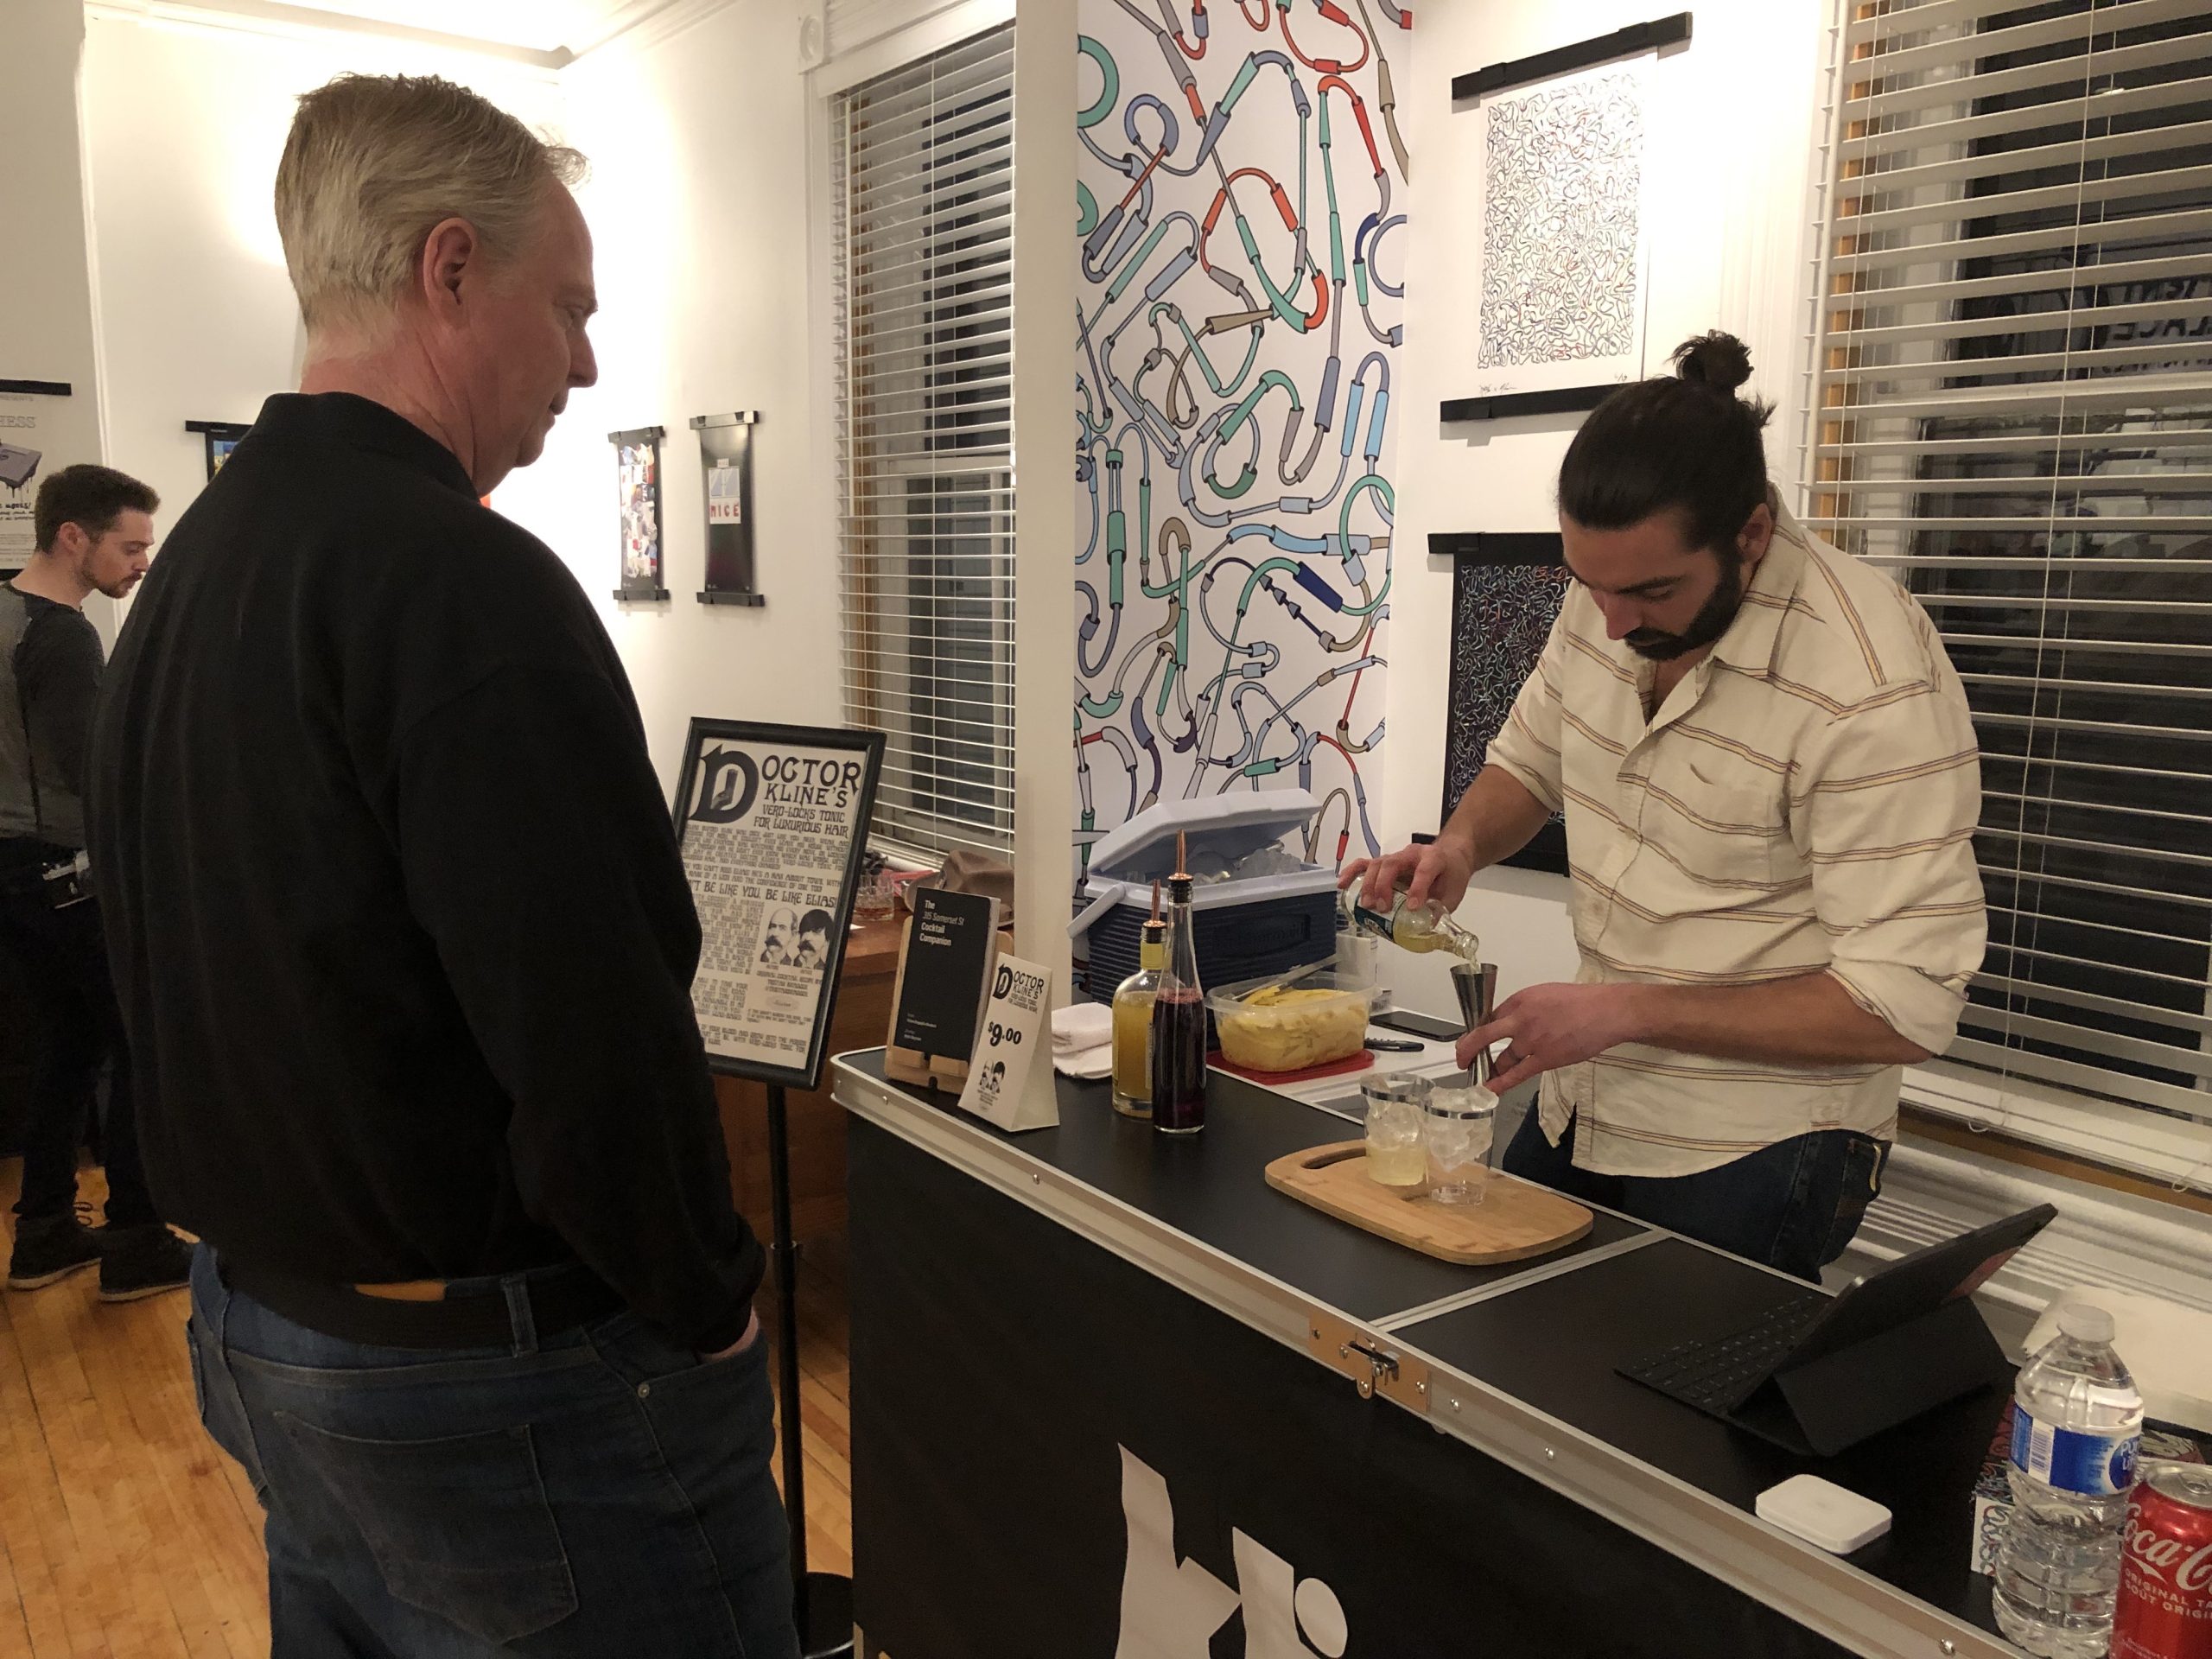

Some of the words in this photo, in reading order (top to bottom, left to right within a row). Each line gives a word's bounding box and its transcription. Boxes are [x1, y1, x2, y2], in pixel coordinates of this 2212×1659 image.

[688, 744, 861, 823] DOCTOR
[765, 783, 849, 808] KLINE'S
[753, 817, 770, 830] FOR
[773, 819, 822, 834] LUXURIOUS
[826, 824, 849, 838] HAIR
[820, 810, 845, 823] TONIC
[704, 881, 715, 893] BE
[719, 883, 738, 896] LIKE
[766, 888, 778, 900] BE
[782, 891, 803, 906] LIKE
[919, 933, 951, 946] Companion
[921, 922, 945, 934] Cocktail
[992, 963, 1044, 999] DOCTOR
[988, 1020, 1022, 1047] $9.00
[2125, 1567, 2189, 1605] ORIGINAL
[2163, 1601, 2212, 1619] ORIGI
